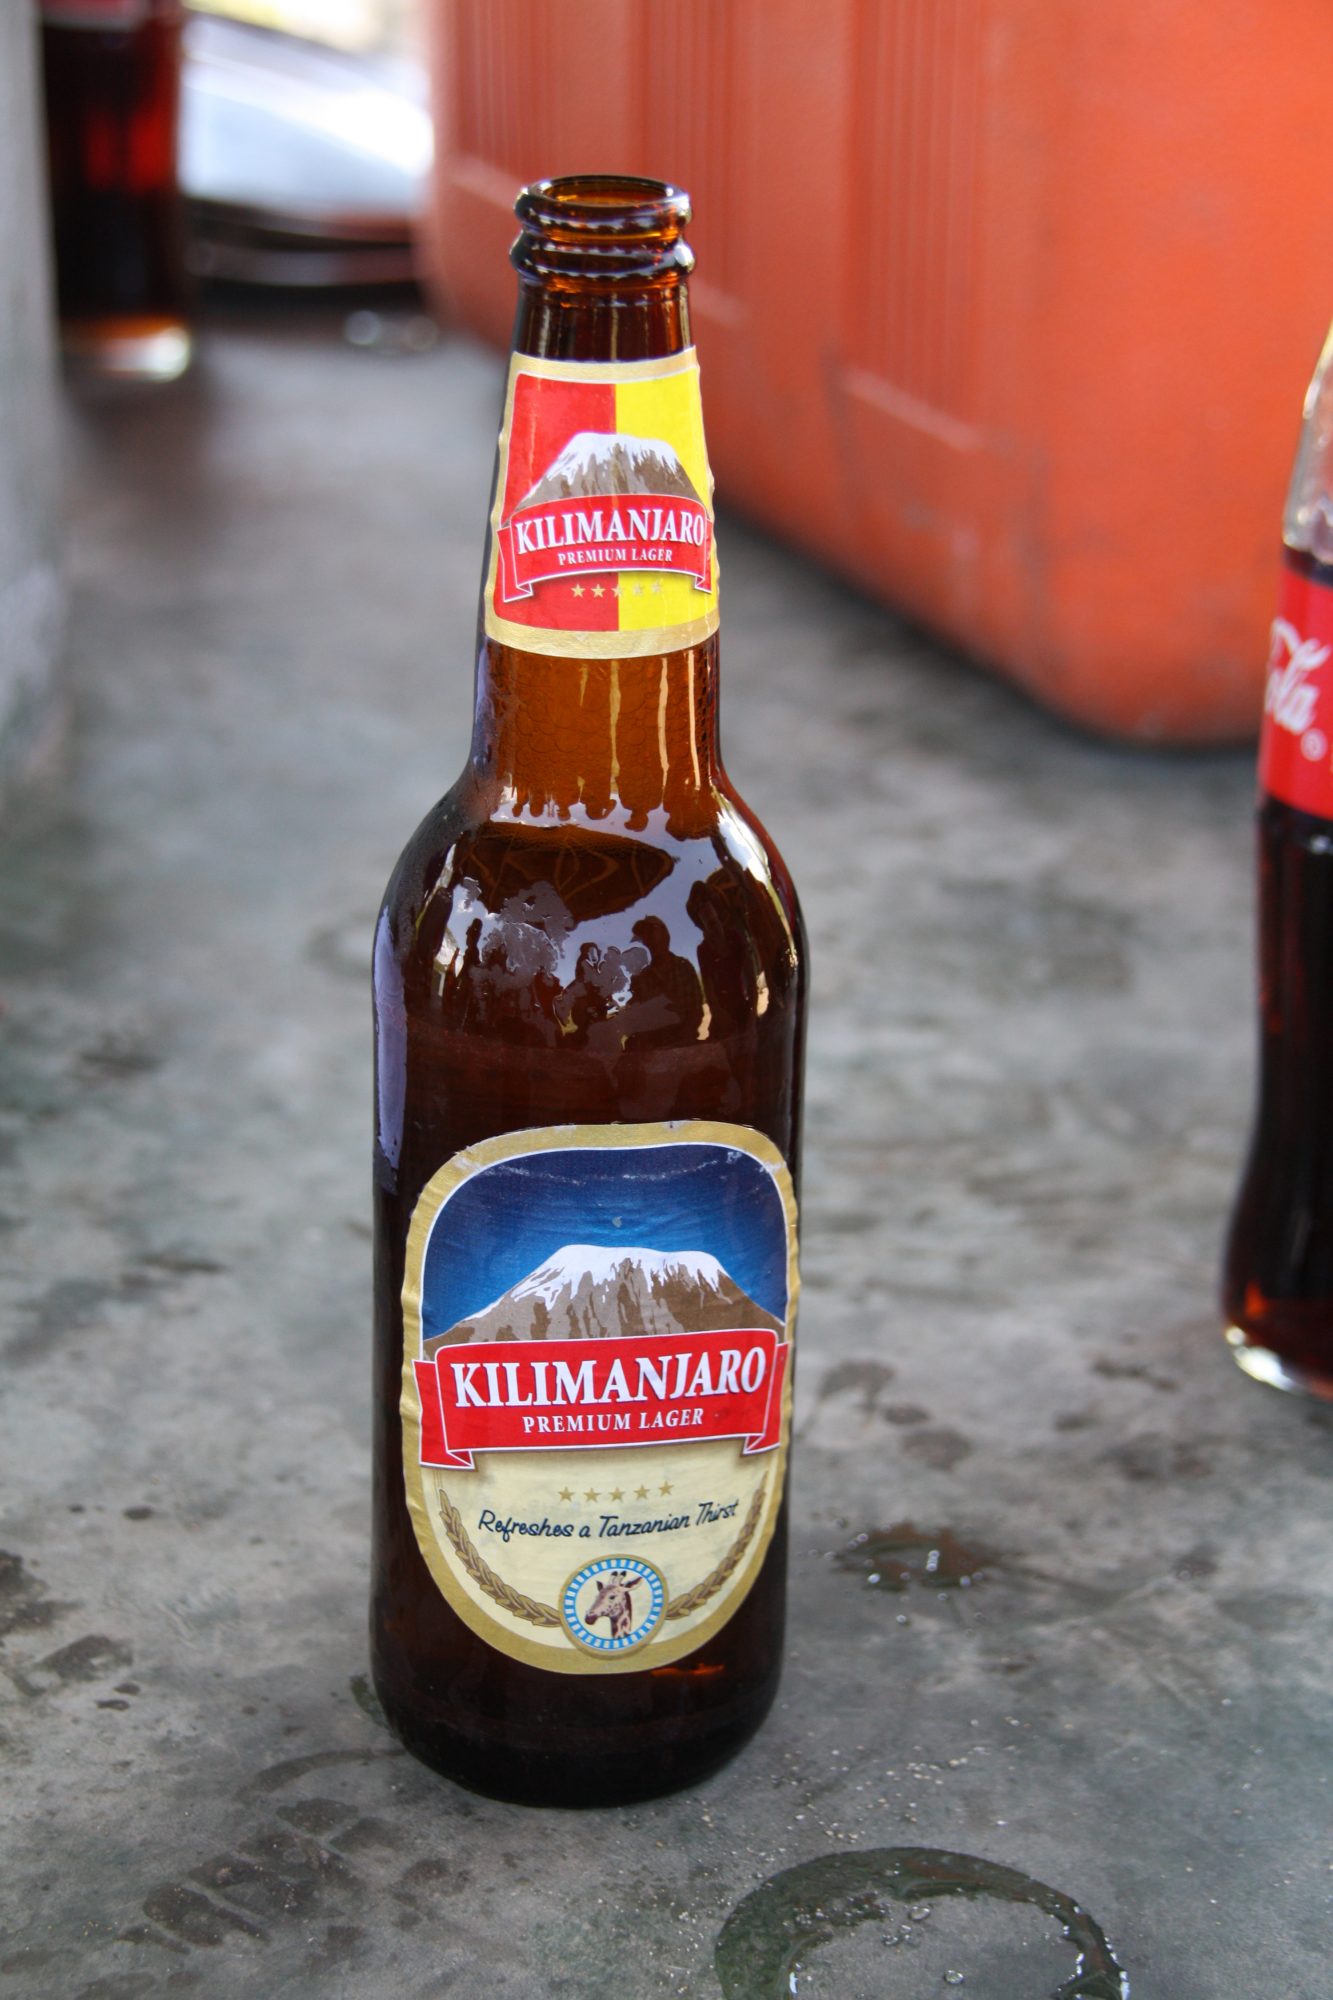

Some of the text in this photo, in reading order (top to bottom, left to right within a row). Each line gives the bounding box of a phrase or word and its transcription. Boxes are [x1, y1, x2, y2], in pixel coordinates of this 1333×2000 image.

[515, 508, 704, 555] KILIMANJARO
[558, 548, 674, 566] PREMIUM LAGER
[450, 1346, 767, 1408] KILIMANJARO
[523, 1407, 704, 1433] PREMIUM LAGER
[479, 1500, 739, 1543] Refreshes a Tanzanian Thirst
